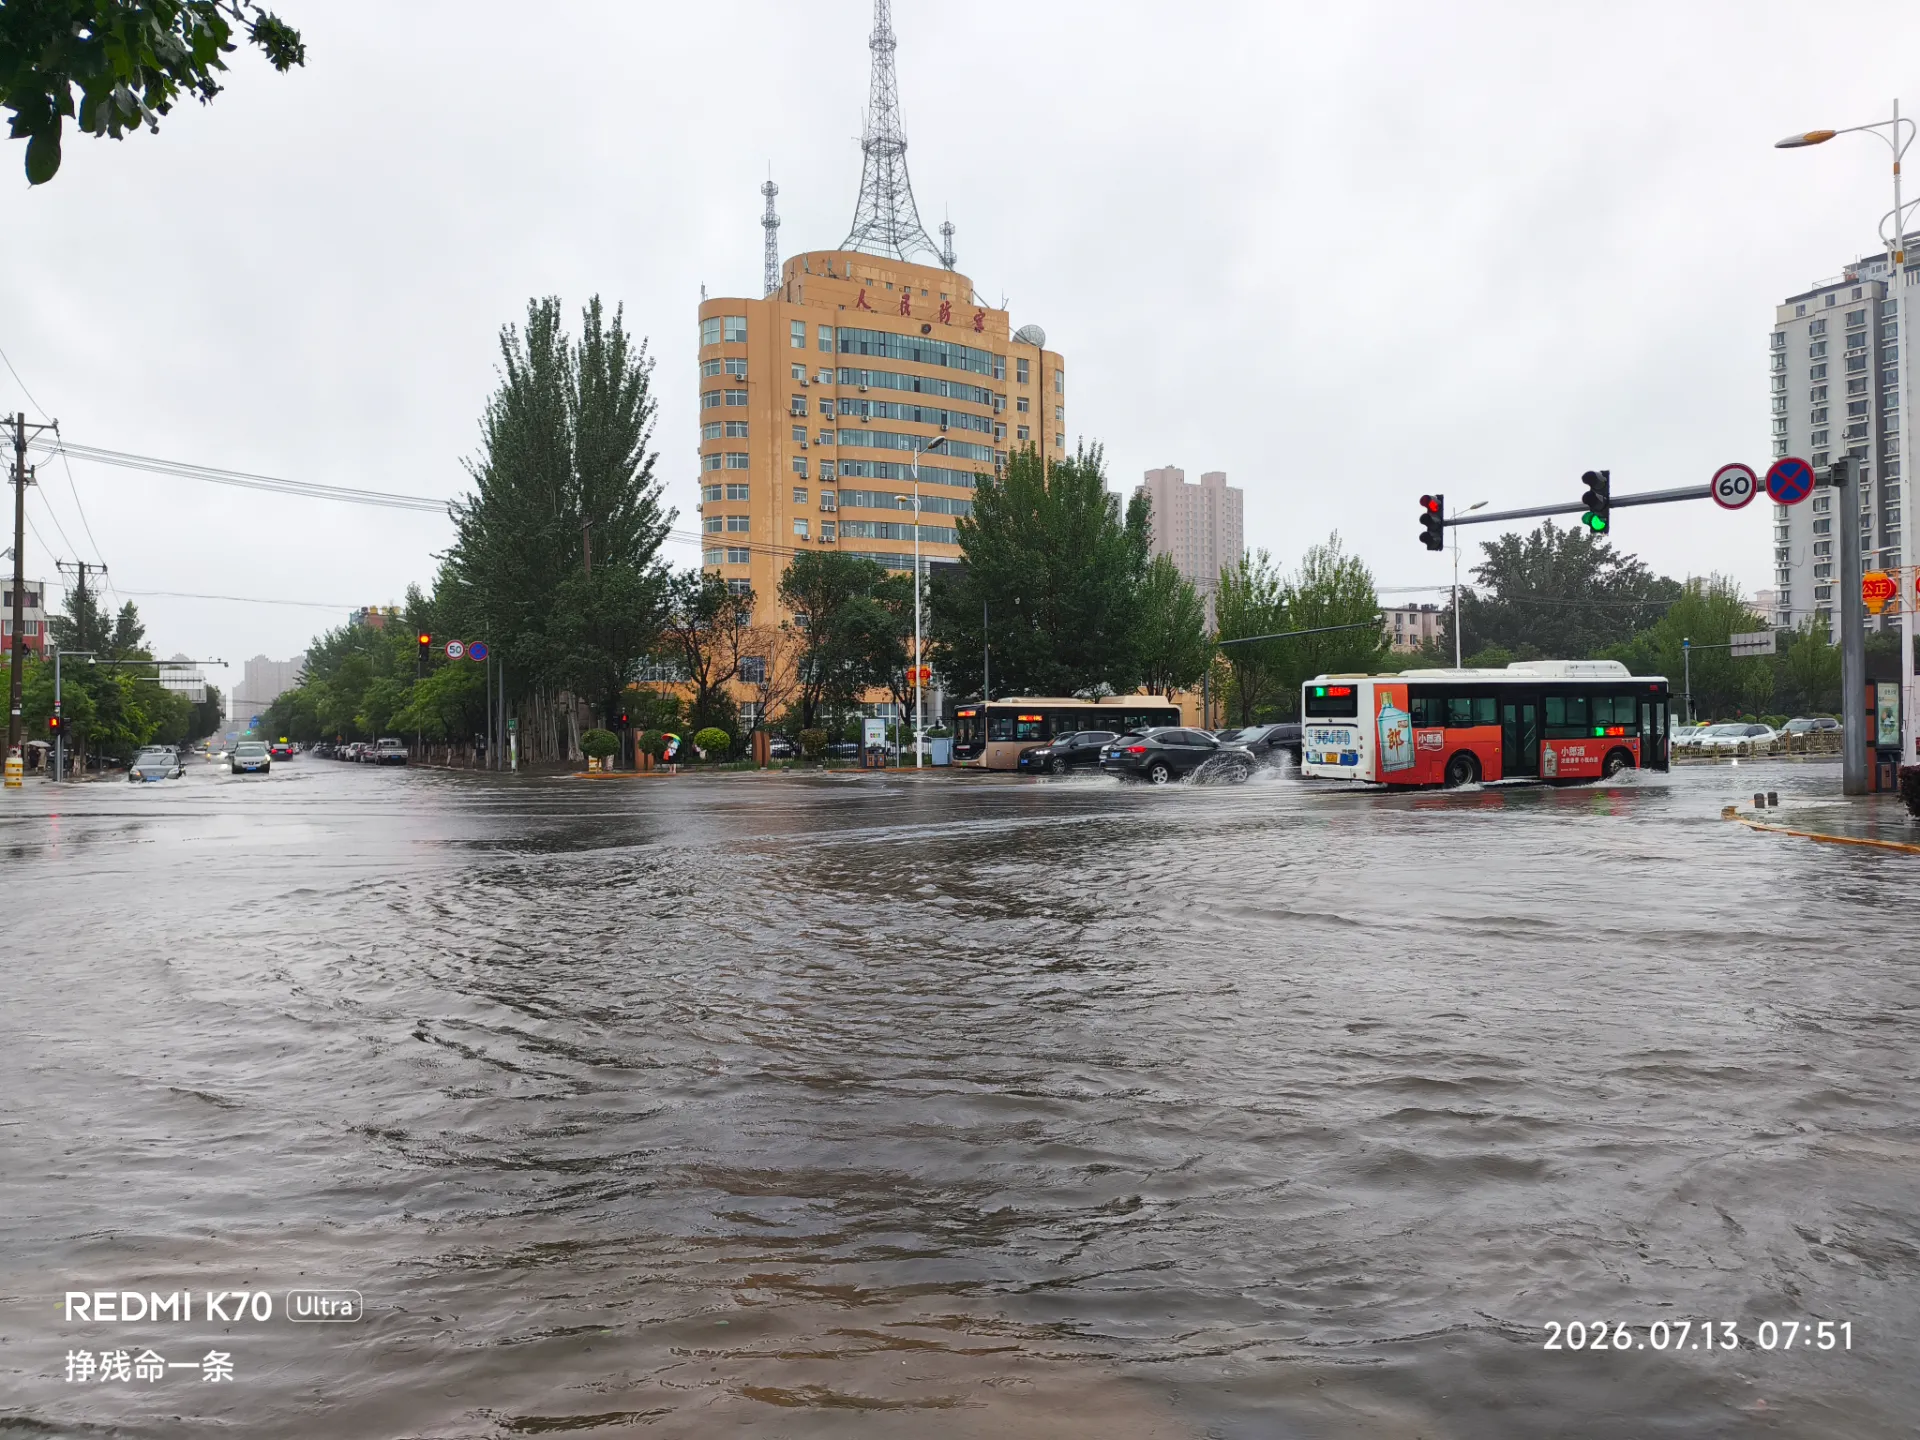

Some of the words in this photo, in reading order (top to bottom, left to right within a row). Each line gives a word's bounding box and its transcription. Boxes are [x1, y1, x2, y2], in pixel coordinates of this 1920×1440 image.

[1719, 476, 1749, 496] 60
[1863, 583, 1887, 595] 公正
[449, 645, 462, 654] 50
[1418, 733, 1442, 745] 小郎酒
[1561, 745, 1585, 757] 小郎酒
